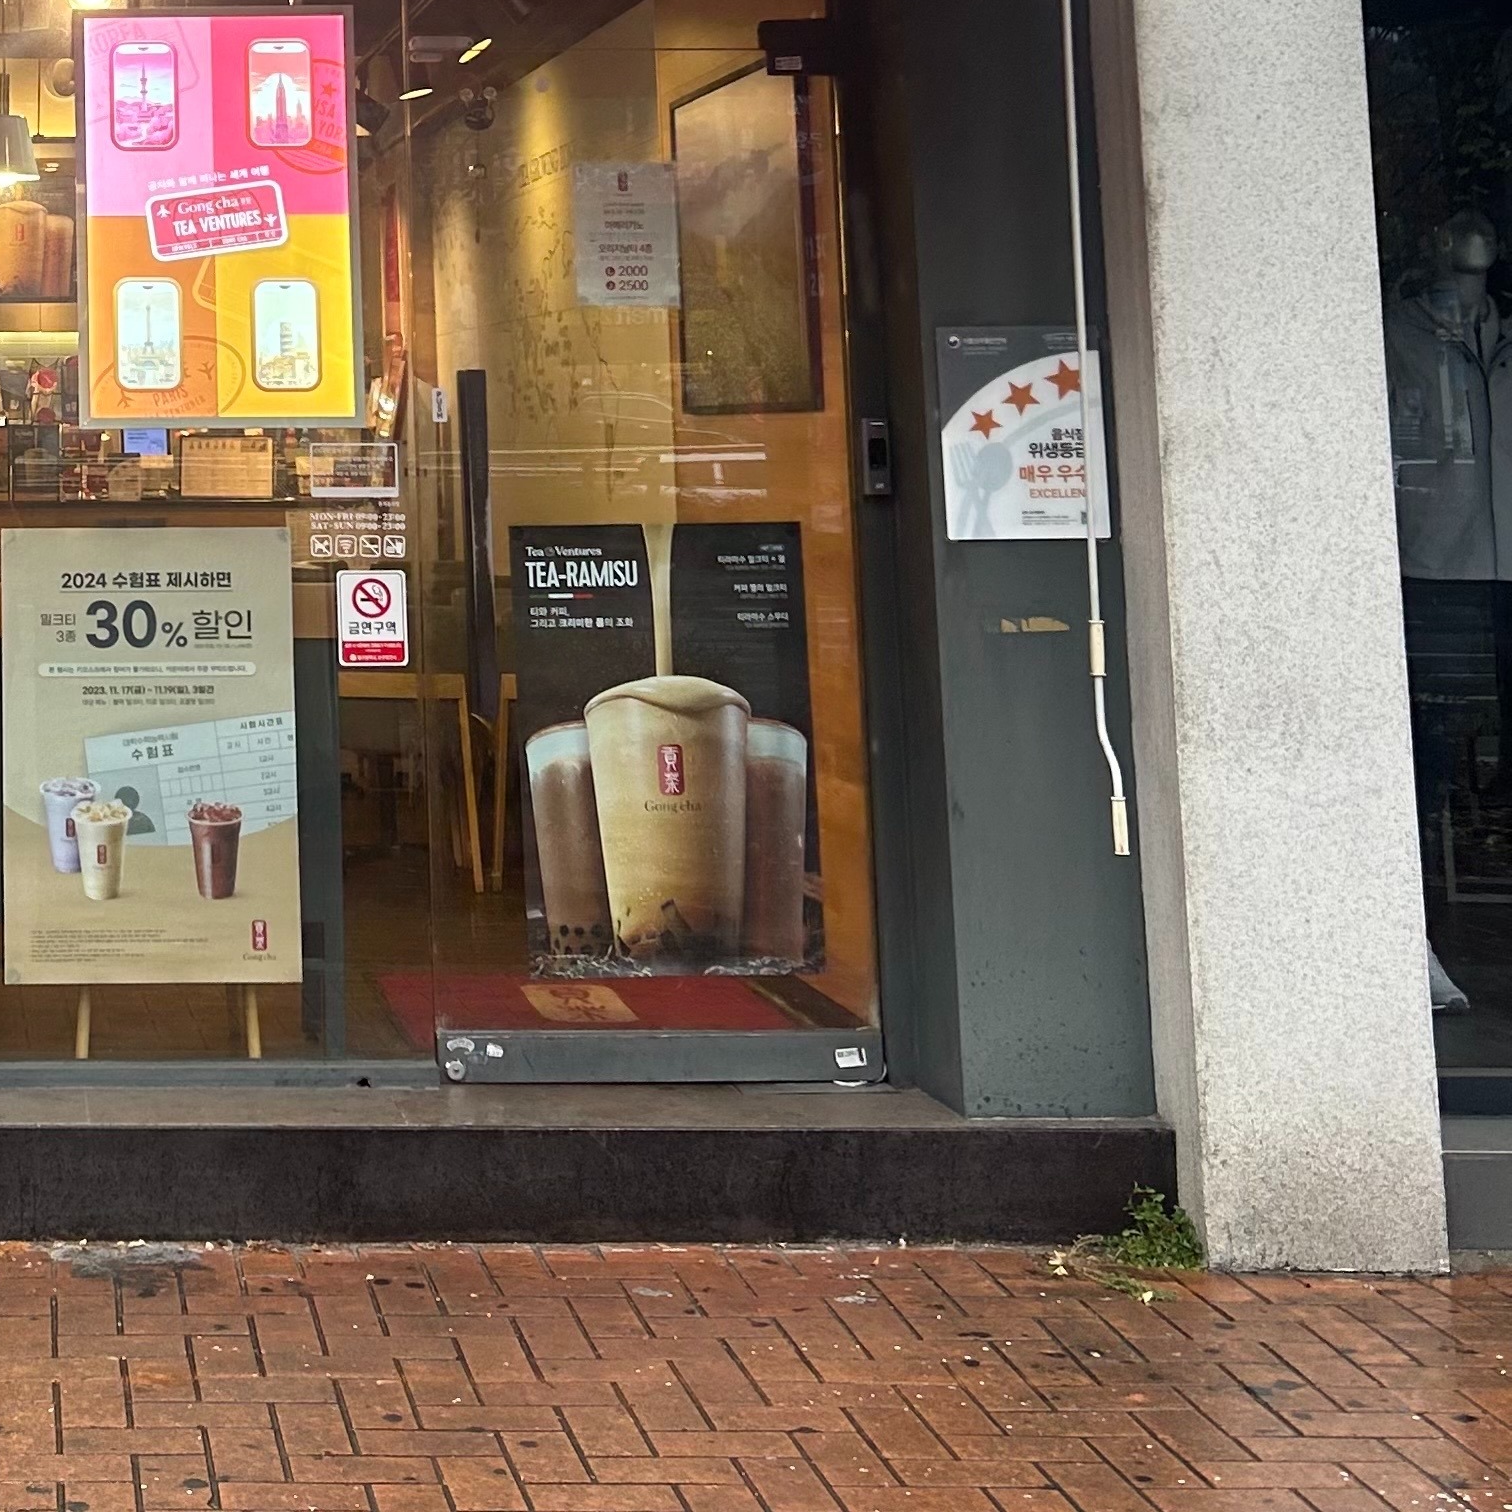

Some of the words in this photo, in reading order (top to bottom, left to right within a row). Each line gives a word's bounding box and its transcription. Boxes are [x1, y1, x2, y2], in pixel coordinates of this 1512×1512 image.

[177, 200, 215, 216] Gong
[215, 195, 239, 209] cha
[172, 219, 197, 237] TEA
[199, 209, 263, 233] VENTURES
[618, 266, 648, 277] 2000
[618, 280, 649, 291] 2500
[1019, 464, 1054, 484] 매우
[1029, 488, 1088, 499] EXCELLEN
[525, 546, 544, 557] Tea
[554, 545, 603, 557] Ventures
[60, 572, 107, 589] 2024
[112, 572, 161, 589] 수험표
[166, 571, 232, 589] 제시하면
[524, 559, 639, 588] TEA-RAMISU
[40, 613, 76, 626] 밀크티
[85, 599, 188, 649] 30%
[192, 609, 253, 640] 할인
[530, 618, 556, 628] 그리고
[348, 621, 397, 635] 금연구역
[56, 630, 76, 643] 3종
[239, 717, 283, 730] 시험시간표
[131, 743, 174, 761] 수험표
[644, 799, 678, 813] Gong
